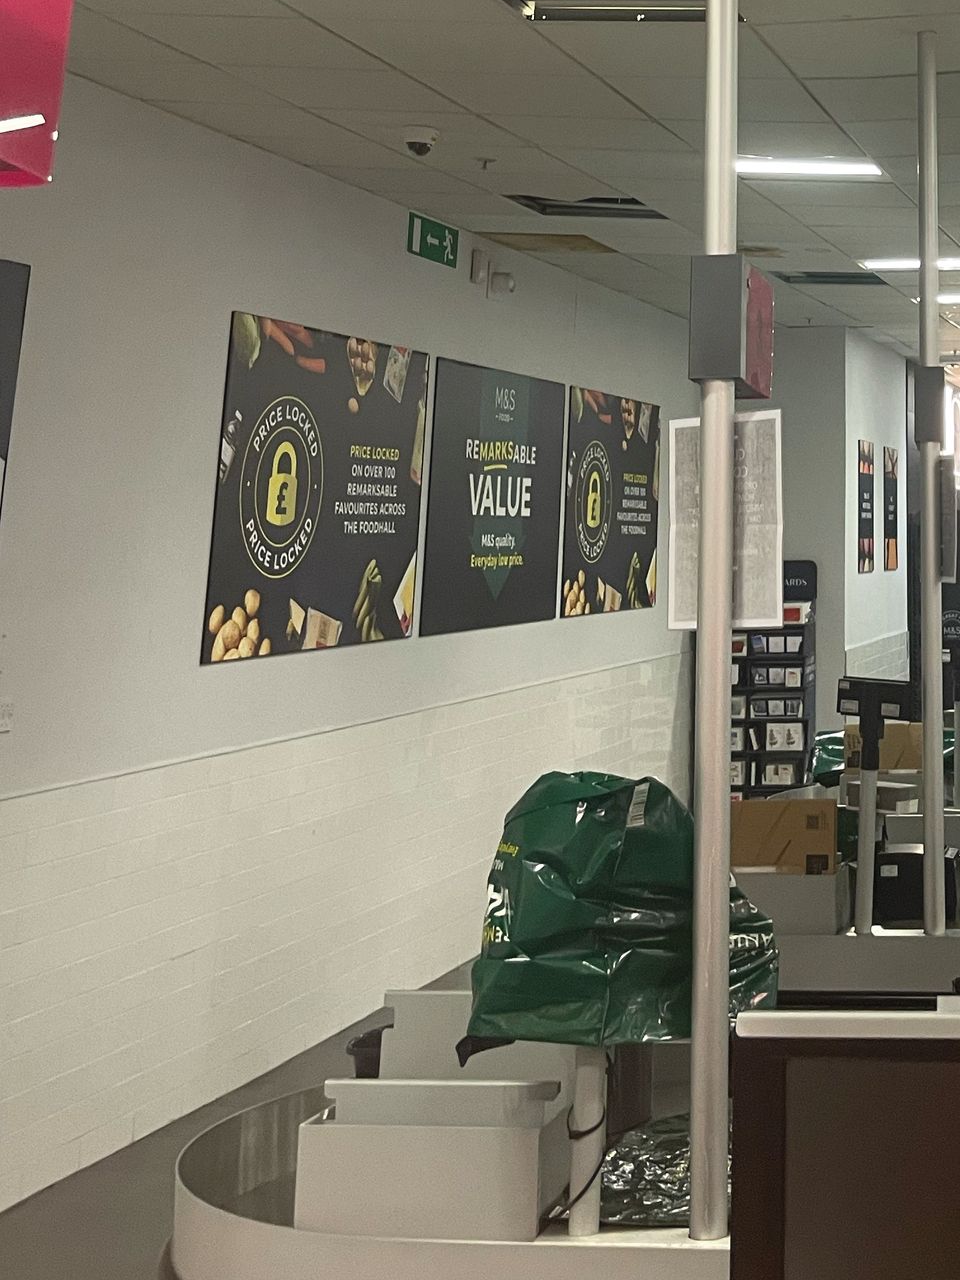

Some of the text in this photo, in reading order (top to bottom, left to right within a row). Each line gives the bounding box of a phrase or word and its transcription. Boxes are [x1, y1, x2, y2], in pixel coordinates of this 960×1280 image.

[495, 386, 516, 411] M&S
[254, 404, 318, 457] PRICE LOCKED
[350, 445, 400, 460] PRICE LOCKED
[466, 438, 537, 465] REMARKSABLE
[351, 464, 396, 479] ON OVER 100
[347, 483, 397, 497] REMARKSABLE
[469, 473, 532, 517] VALUE
[334, 502, 406, 515] FAVOURITES ACROSS
[344, 521, 395, 534] THE FOODHALL
[246, 518, 312, 570] PRICE LOCKED
[481, 533, 495, 547] M&S
[470, 553, 497, 570] Everyday
